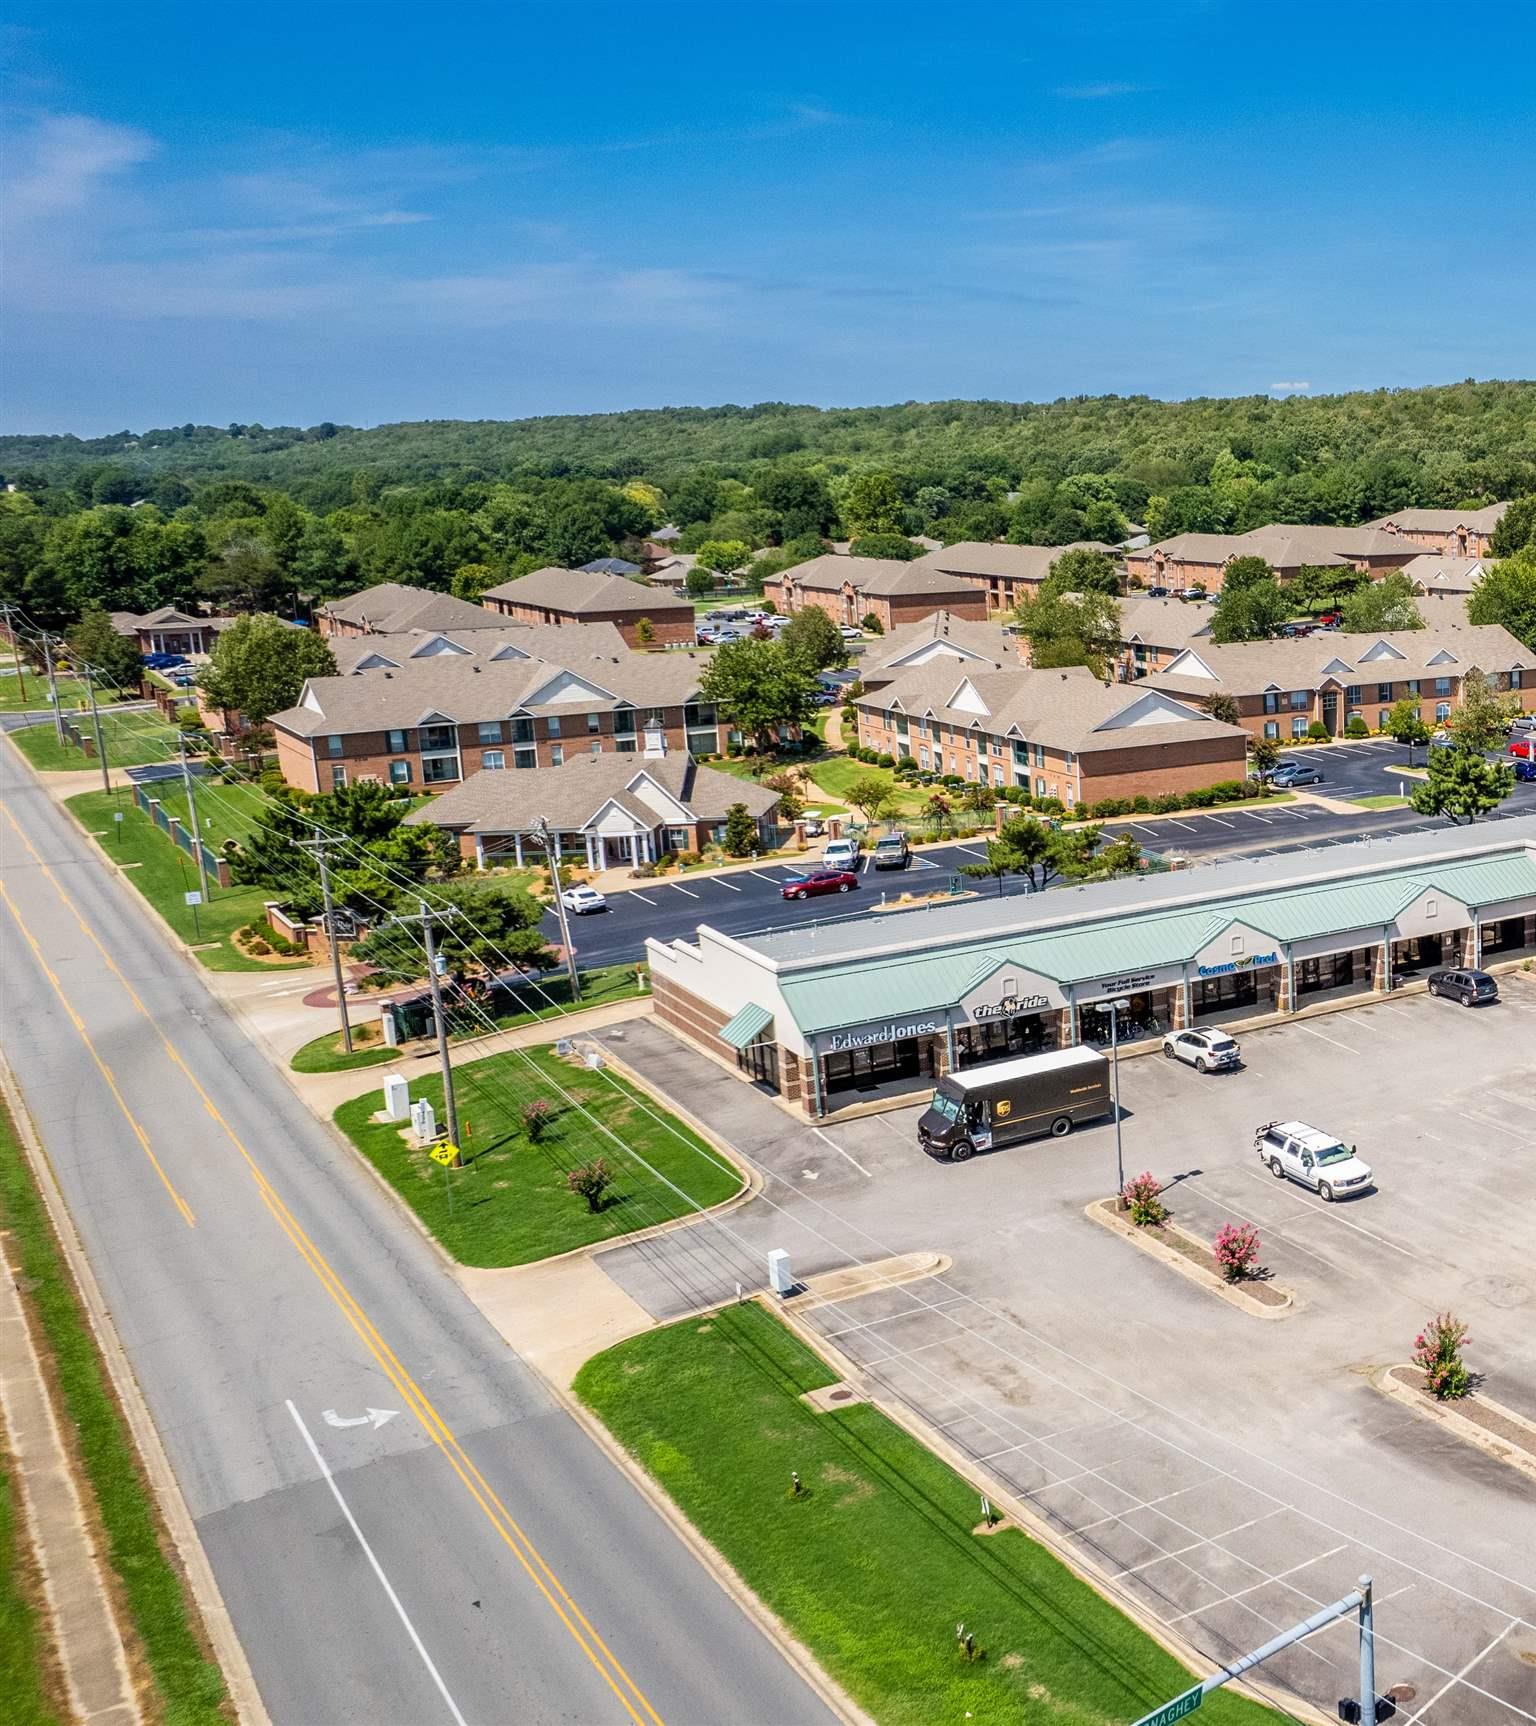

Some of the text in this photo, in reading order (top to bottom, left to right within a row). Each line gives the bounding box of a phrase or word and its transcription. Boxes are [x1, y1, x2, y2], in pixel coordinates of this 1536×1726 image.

[974, 995, 1048, 1018] the ride
[888, 1021, 936, 1042] Jones
